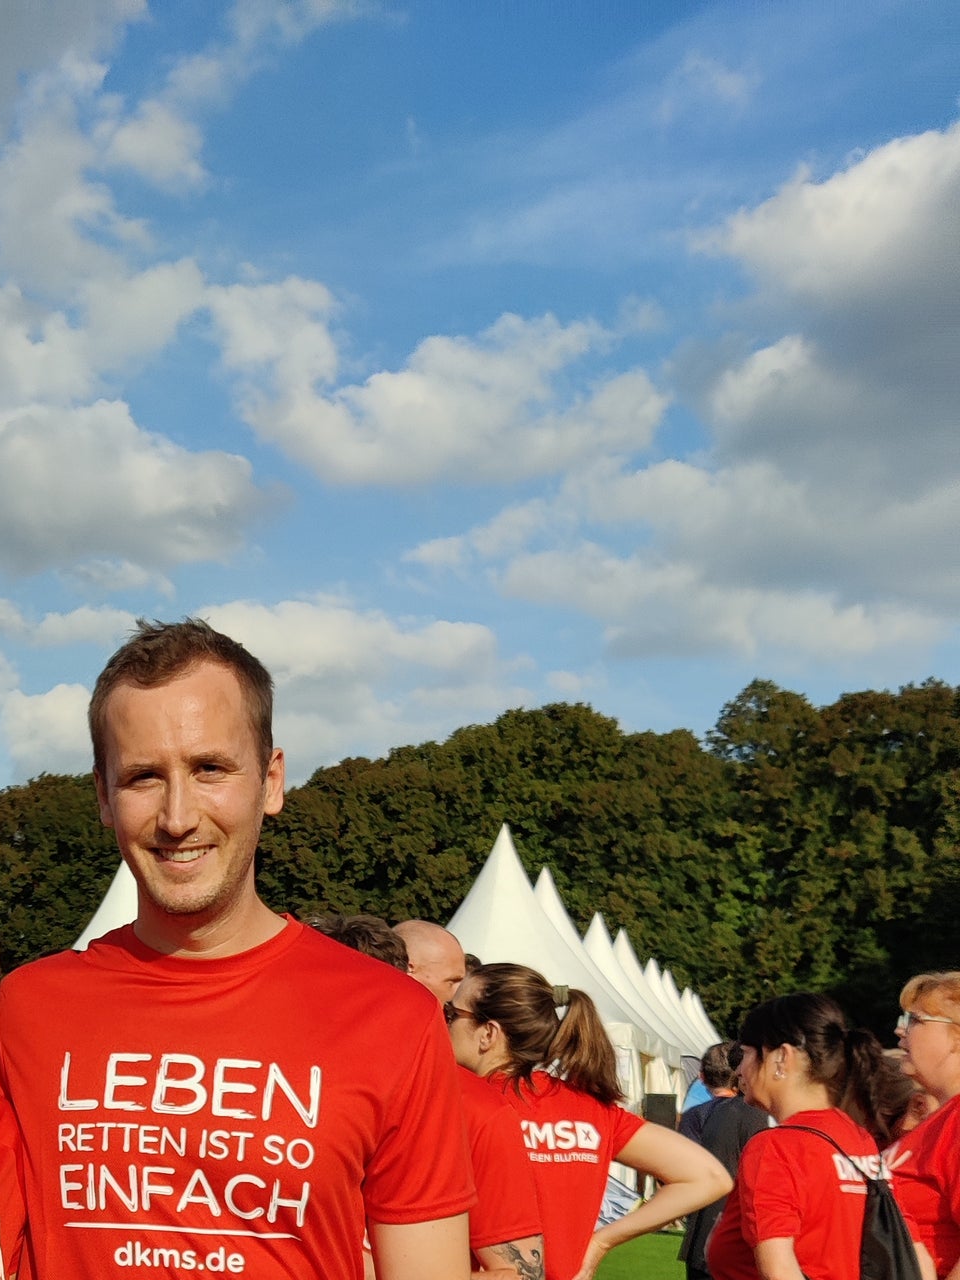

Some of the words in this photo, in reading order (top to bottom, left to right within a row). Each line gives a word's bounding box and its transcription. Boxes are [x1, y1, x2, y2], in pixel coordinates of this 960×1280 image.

[58, 1051, 321, 1129] LEBEN
[58, 1122, 187, 1157] RETTEN
[198, 1129, 255, 1162] IST
[262, 1135, 315, 1170] SO
[59, 1160, 313, 1227] EINFACH
[113, 1240, 245, 1274] dkms.de
